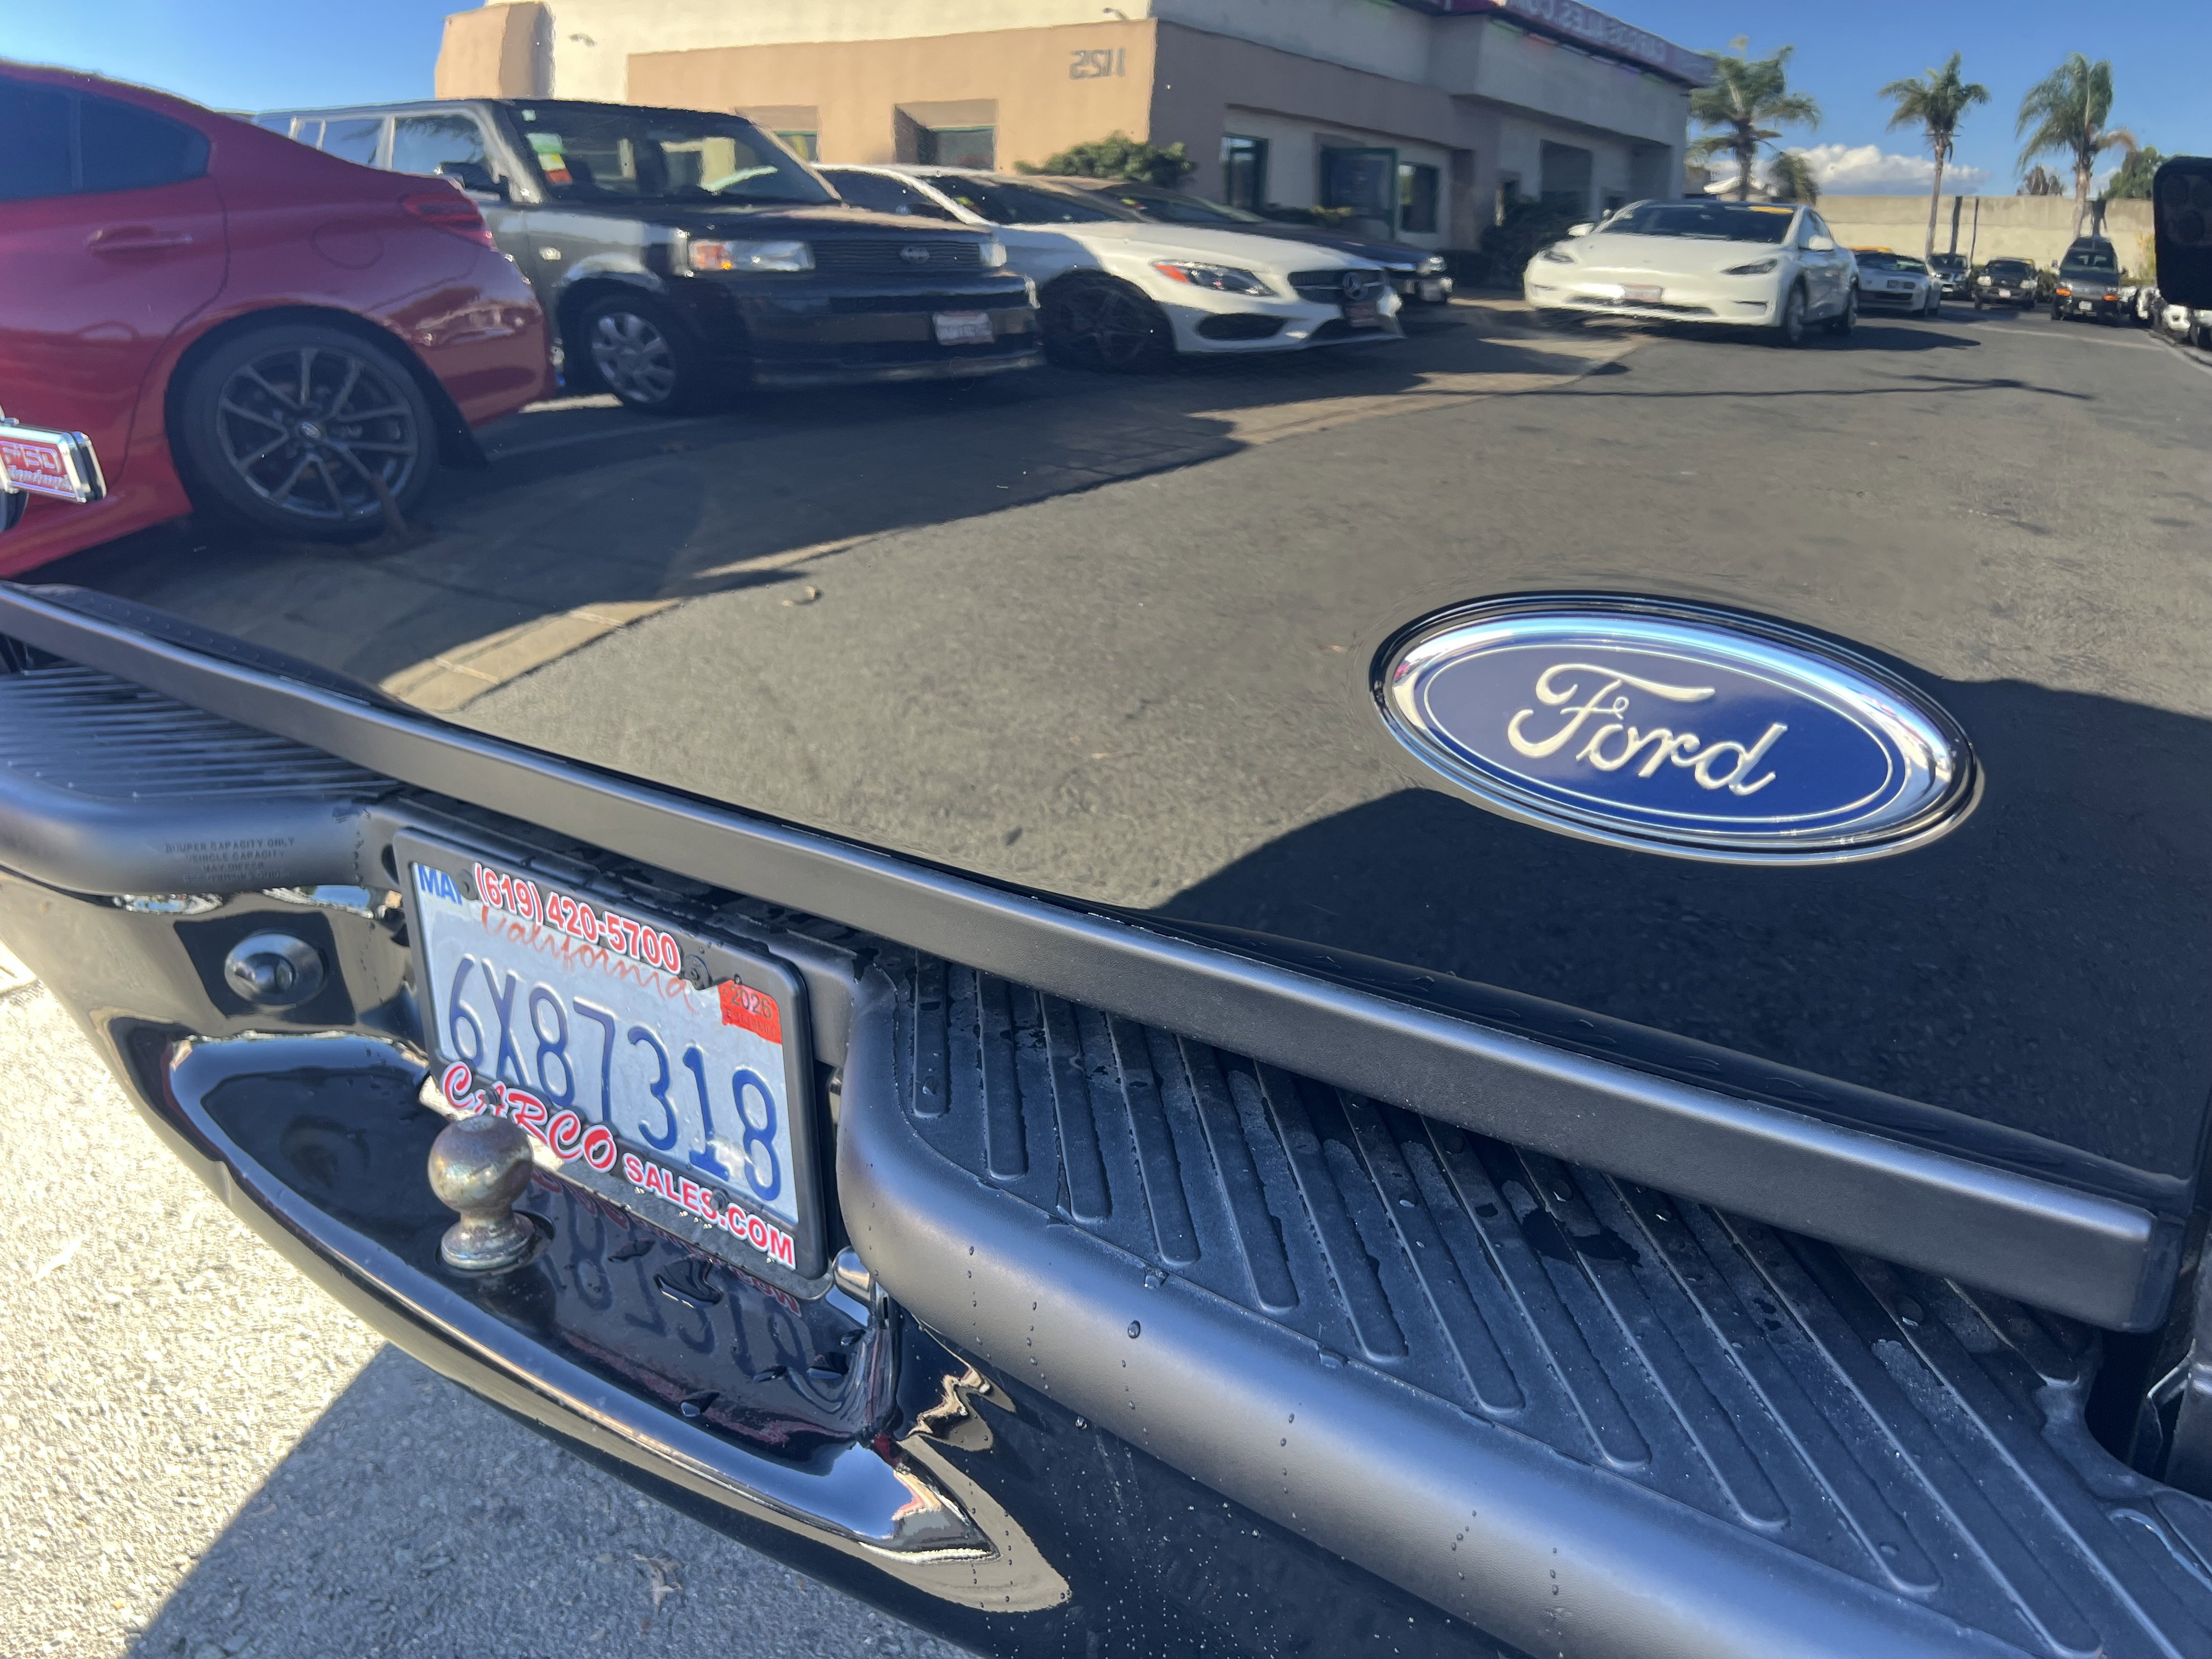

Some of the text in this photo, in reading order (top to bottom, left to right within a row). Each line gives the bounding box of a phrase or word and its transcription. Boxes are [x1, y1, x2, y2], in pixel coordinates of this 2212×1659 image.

[1508, 663, 1788, 796] Ford
[474, 862, 681, 975] (619) 420-5700
[730, 984, 772, 1019] 2026
[449, 955, 781, 1201] 6X87318
[622, 1152, 797, 1270] SALES.COM
